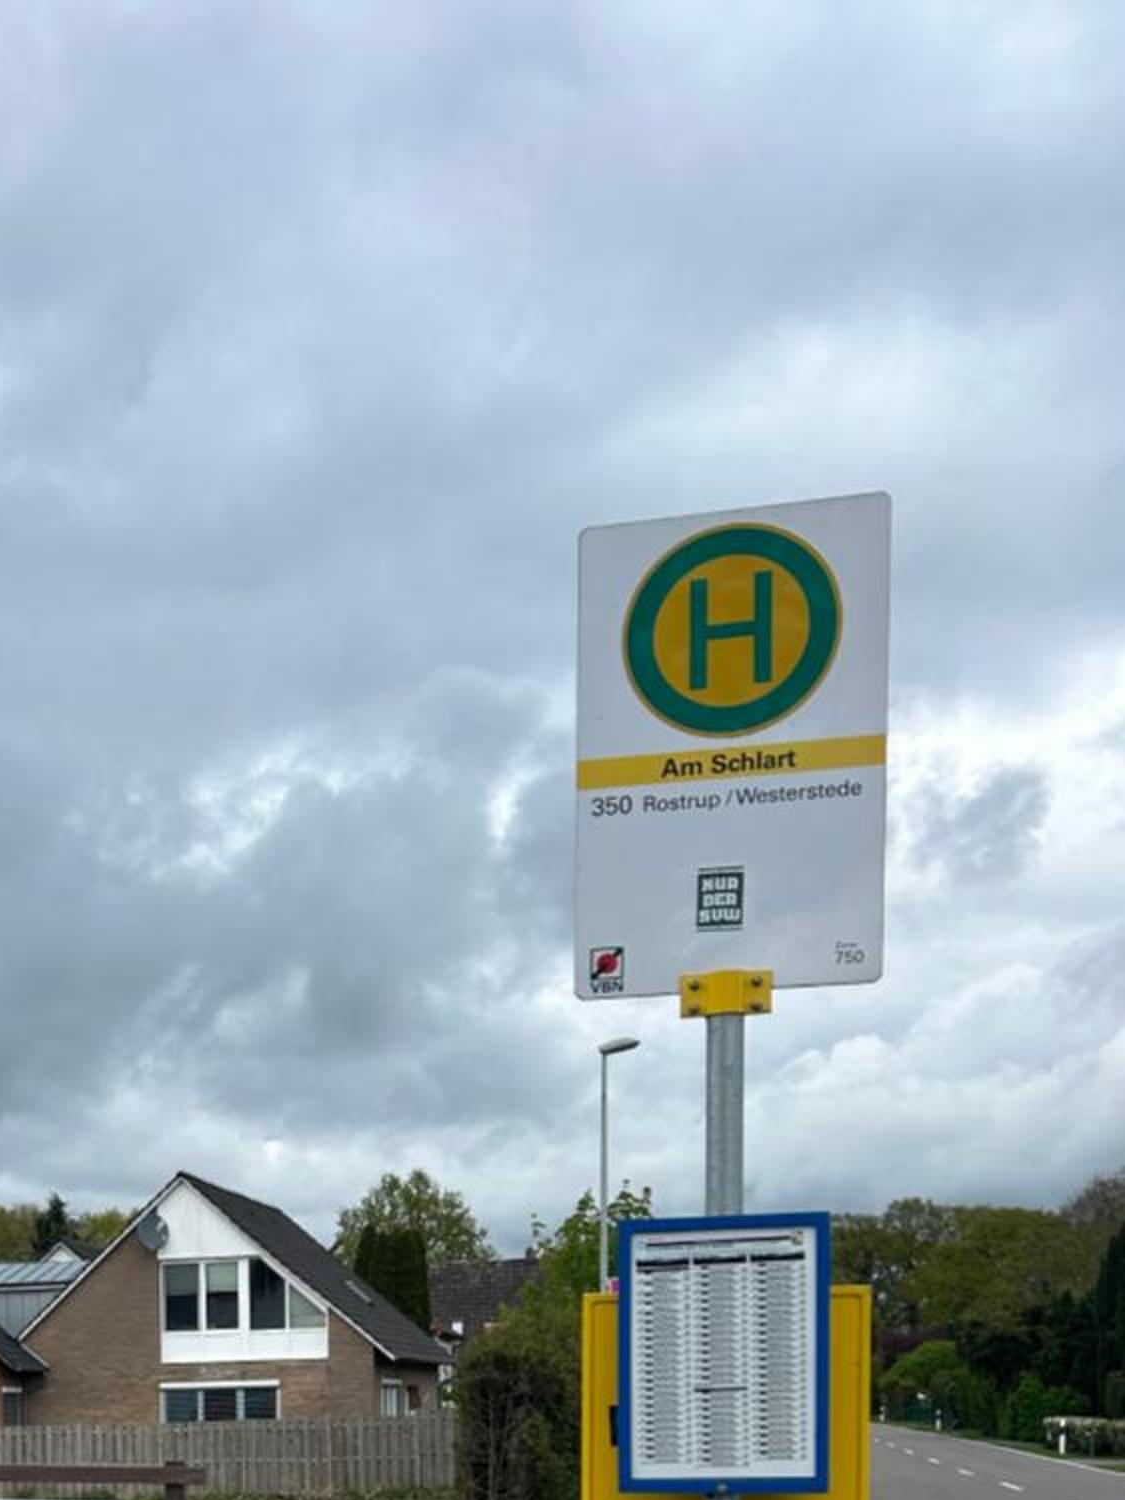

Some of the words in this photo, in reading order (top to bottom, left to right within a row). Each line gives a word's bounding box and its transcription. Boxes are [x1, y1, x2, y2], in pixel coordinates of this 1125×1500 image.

[690, 570, 773, 690] H
[661, 758, 703, 779] Am
[711, 750, 796, 775] Schlart
[590, 794, 633, 817] 350
[642, 792, 721, 813] Rostrup
[835, 949, 866, 965] 750
